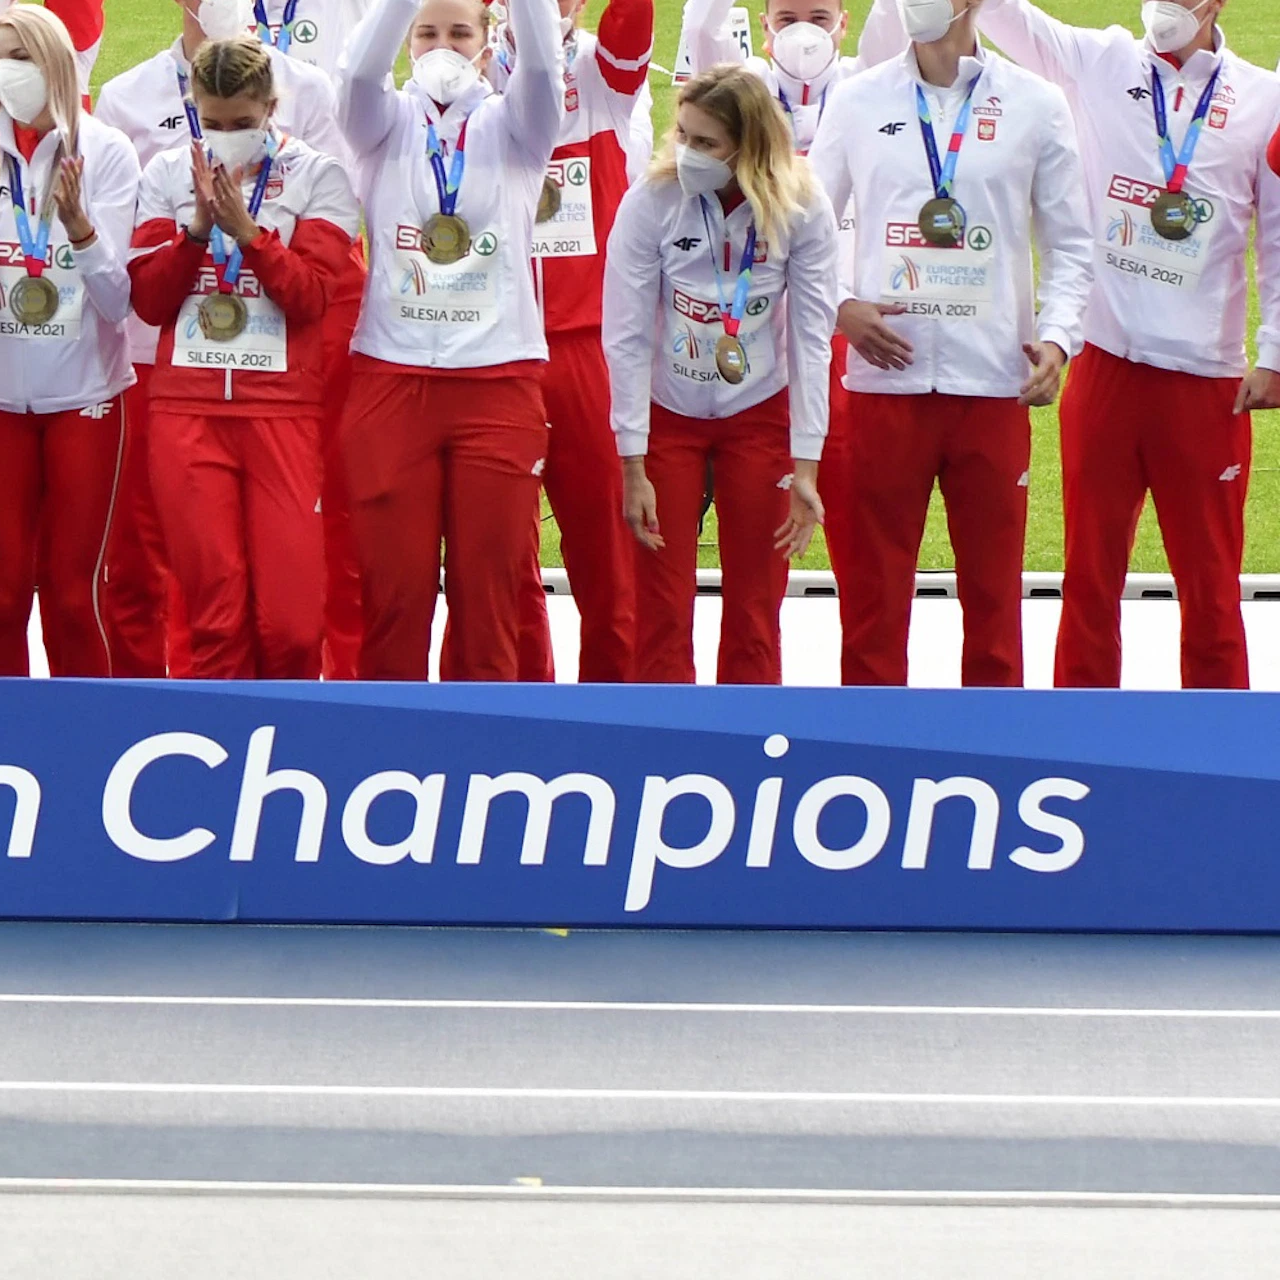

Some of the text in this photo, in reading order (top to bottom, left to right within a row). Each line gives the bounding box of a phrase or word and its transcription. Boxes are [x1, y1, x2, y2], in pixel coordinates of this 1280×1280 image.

[1108, 178, 1161, 206] SPA
[553, 240, 581, 253] 2021
[926, 265, 987, 275] EUROPEAN
[1105, 252, 1184, 287] SILESIA 2021
[400, 306, 480, 322] SILESIA 2021
[674, 292, 724, 322] SPA
[945, 303, 977, 317] 2021
[33, 323, 66, 337] 2021
[187, 351, 273, 367] SILESIA 2021
[672, 363, 722, 382] SILESIA
[78, 401, 114, 420] 4F
[100, 724, 1093, 912] Champions
